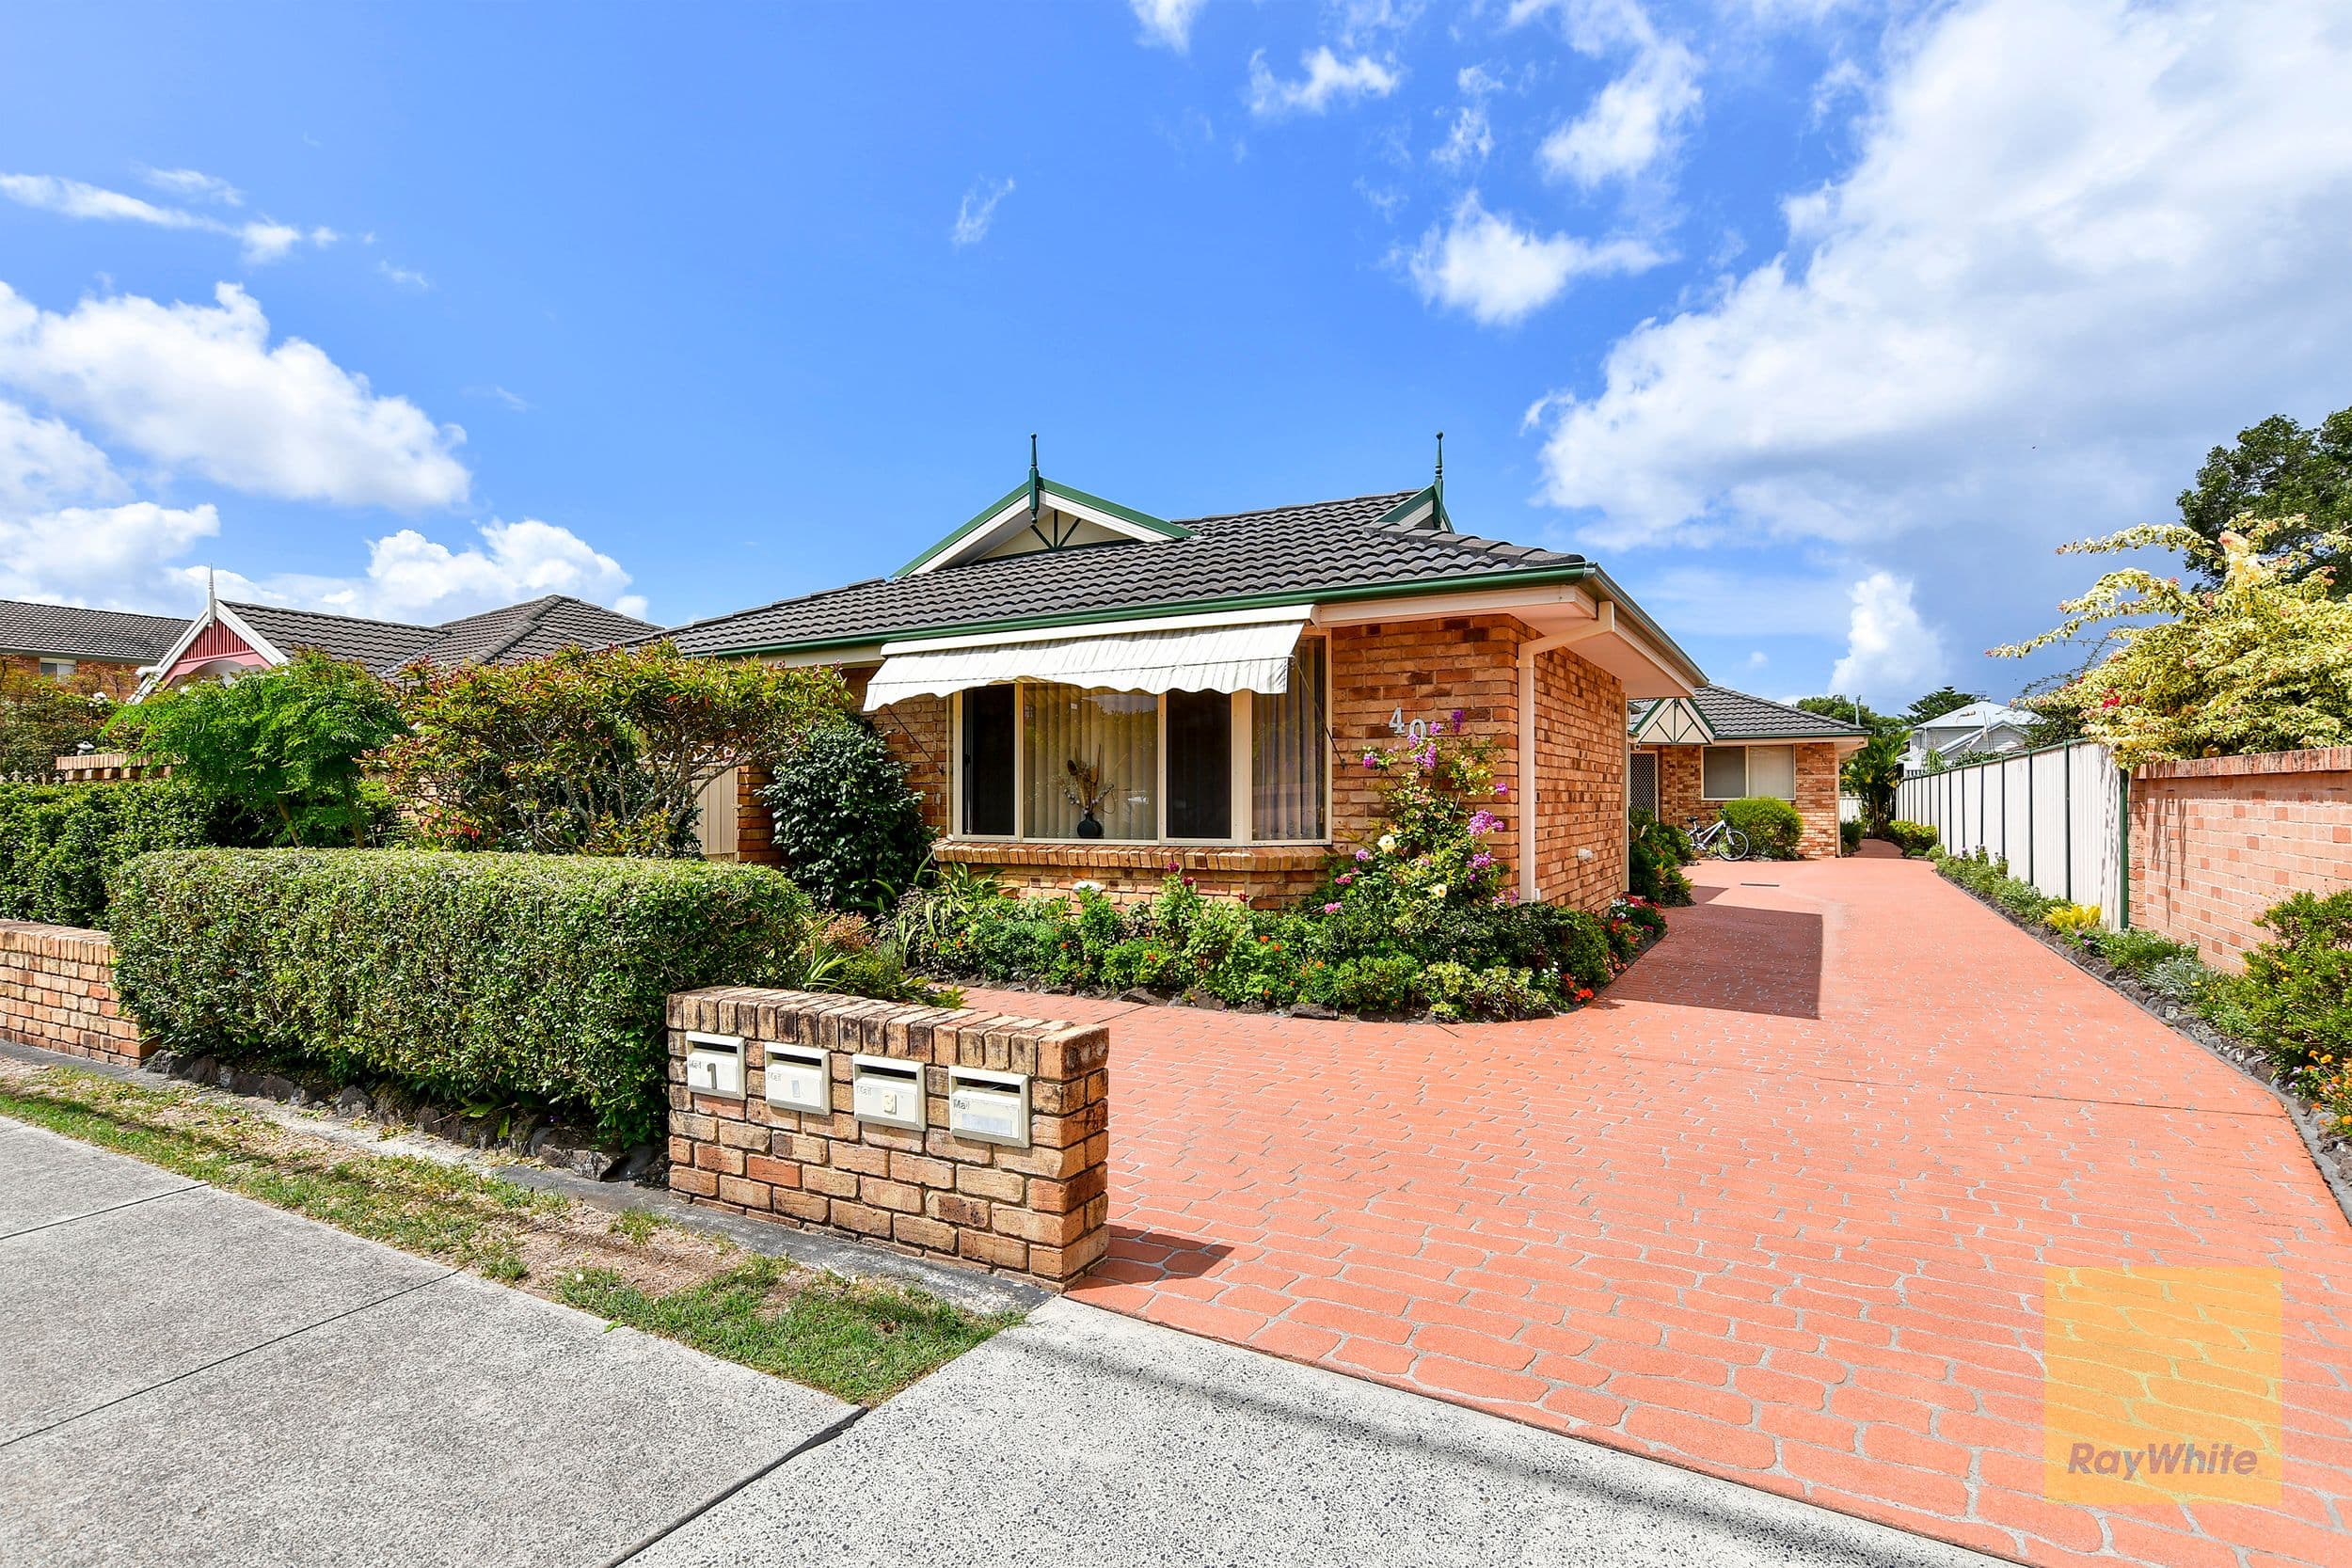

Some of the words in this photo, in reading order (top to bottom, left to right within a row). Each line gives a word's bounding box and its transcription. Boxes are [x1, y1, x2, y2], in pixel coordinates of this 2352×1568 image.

[1389, 706, 1427, 741] 40
[707, 1063, 718, 1089] 1
[883, 1093, 897, 1115] 3
